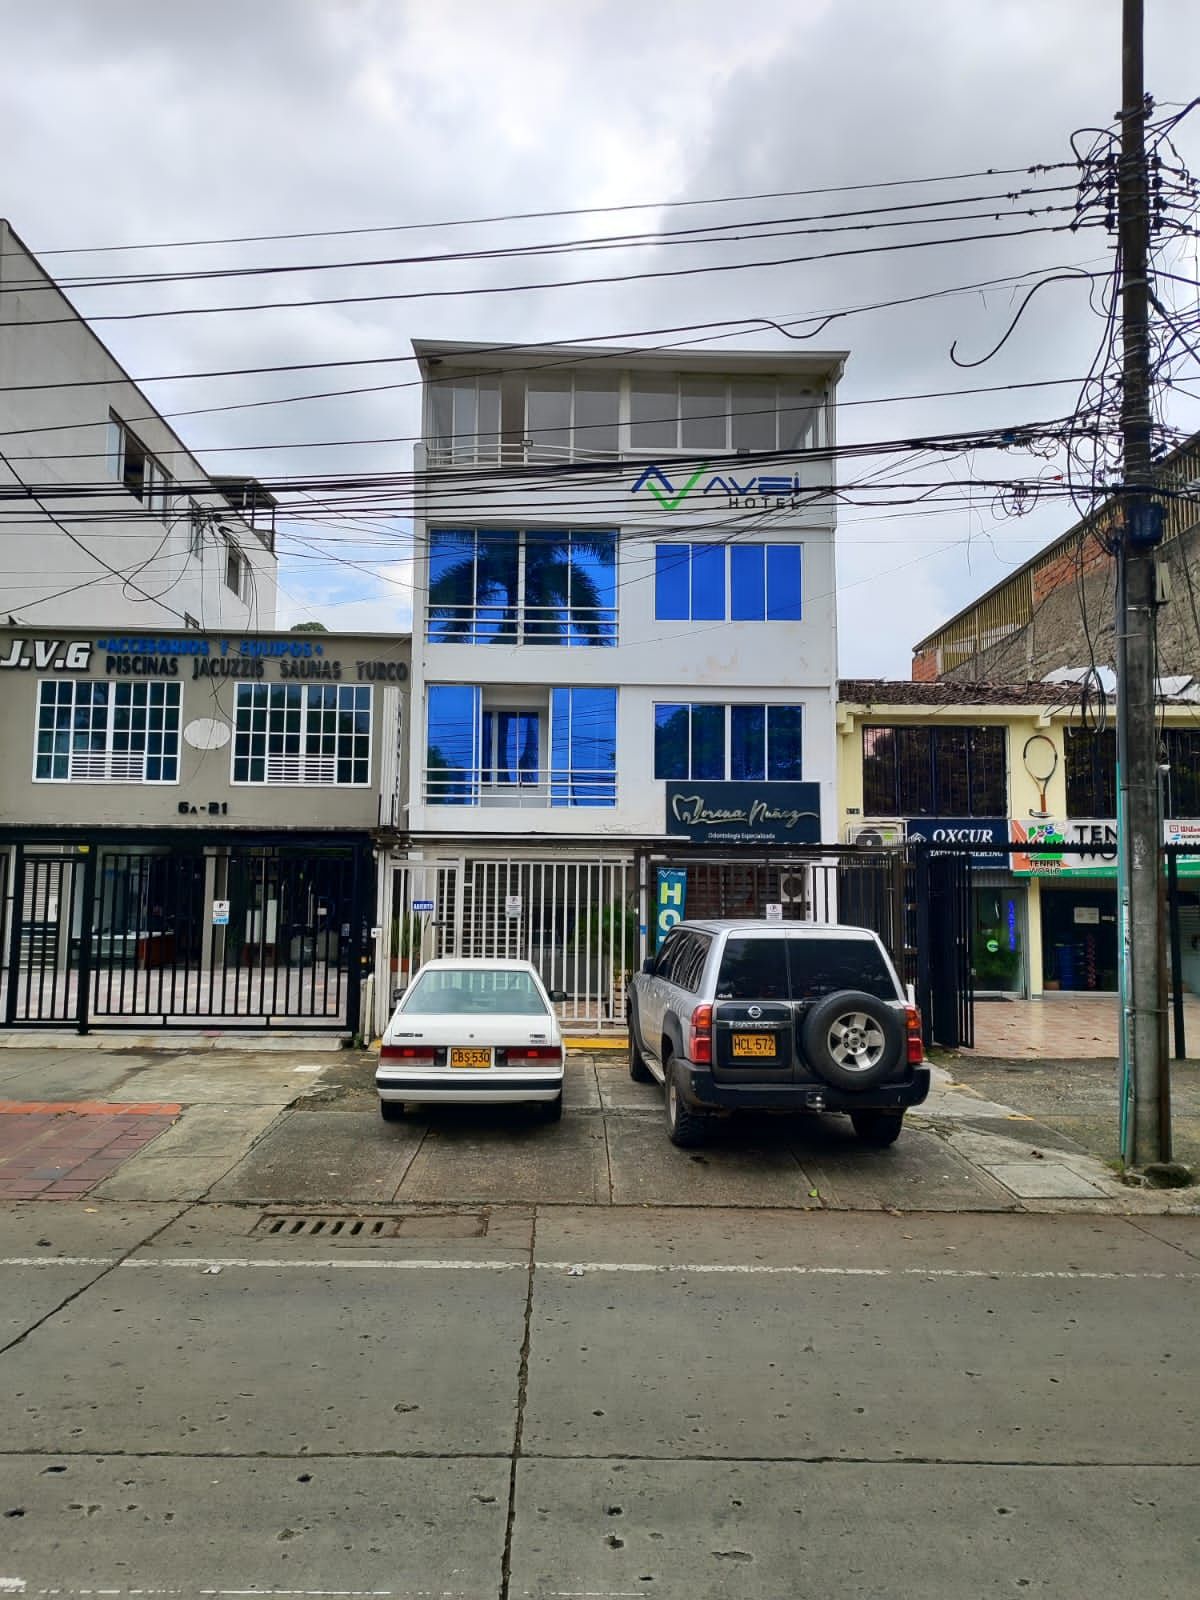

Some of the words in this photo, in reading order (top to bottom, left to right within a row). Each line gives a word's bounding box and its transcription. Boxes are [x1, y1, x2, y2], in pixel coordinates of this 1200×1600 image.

[729, 497, 799, 510] HOTEL
[0, 639, 93, 672] J.V.G
[106, 656, 178, 676] PISCINAS
[192, 657, 265, 680] JACUZZIS
[279, 660, 342, 680] SAUNAS
[356, 660, 409, 681] TURCO
[932, 829, 993, 844] OXCUR
